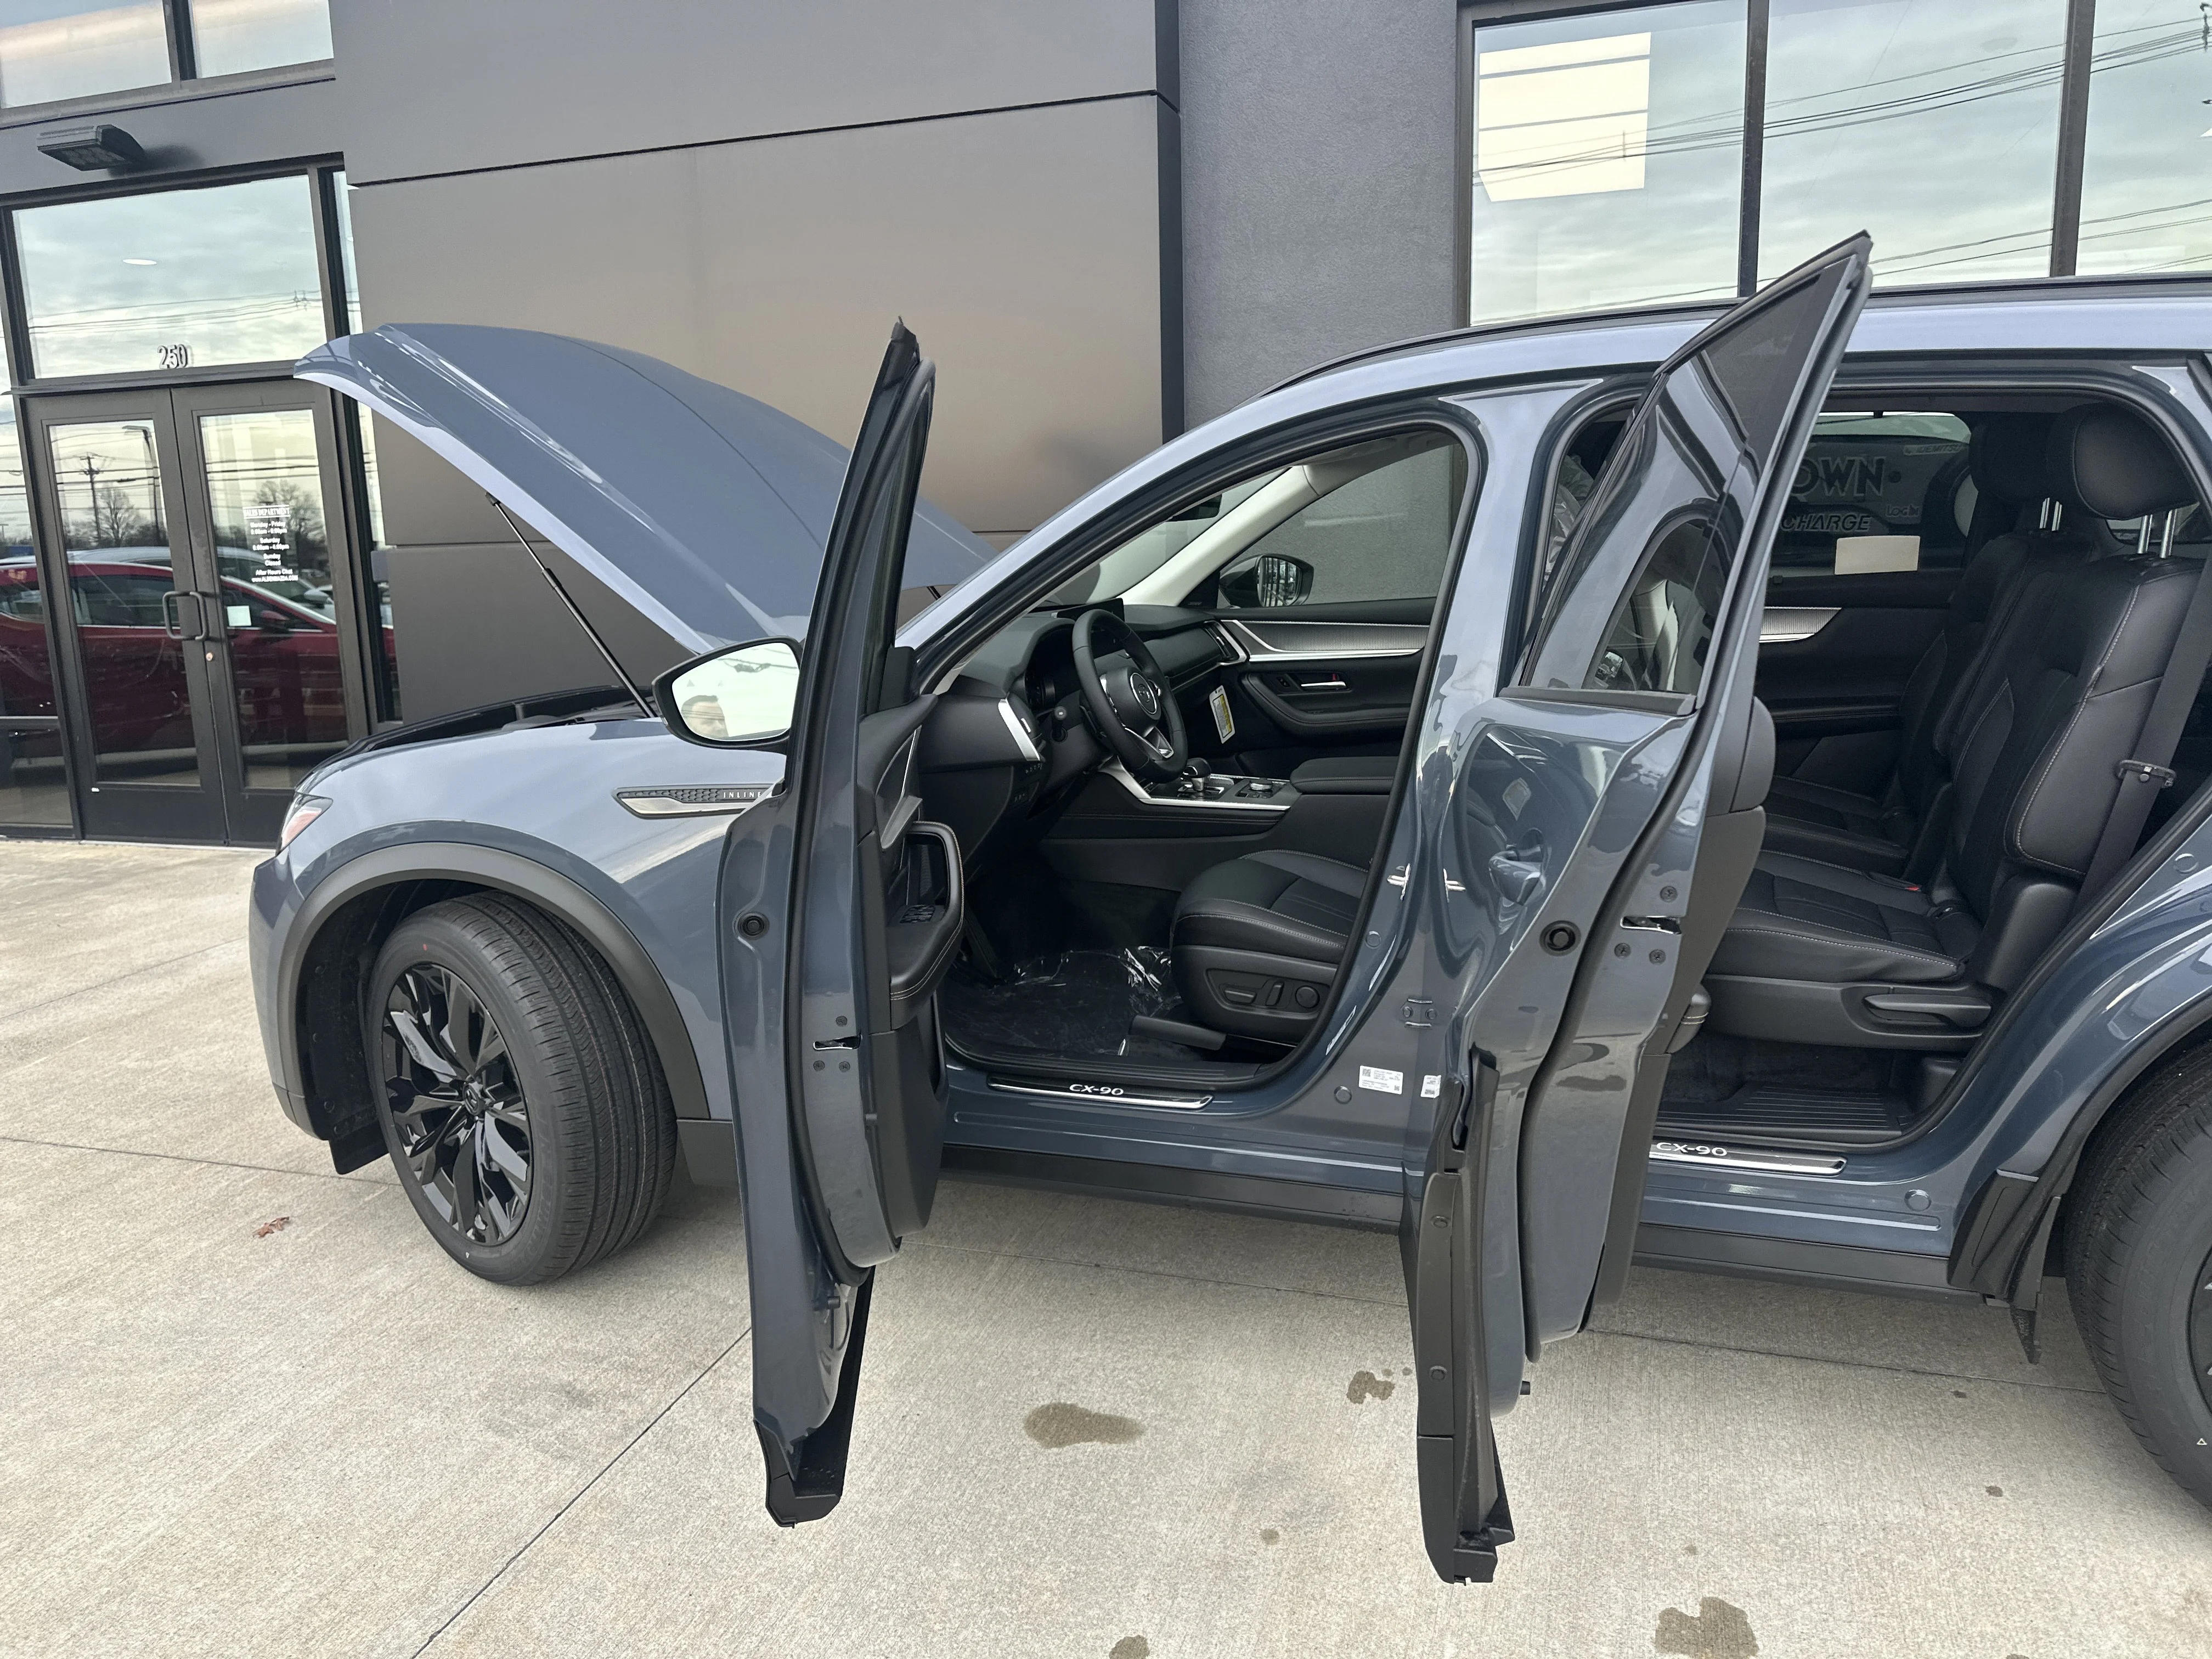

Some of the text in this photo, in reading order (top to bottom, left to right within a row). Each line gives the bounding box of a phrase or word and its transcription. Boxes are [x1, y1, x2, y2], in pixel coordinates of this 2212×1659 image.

[157, 343, 188, 369] 250
[258, 507, 290, 516] DEPARTMENT
[1781, 512, 1871, 532] CHARGE
[1069, 1084, 1124, 1096] CX-90
[1656, 1142, 1727, 1156] CX-90
